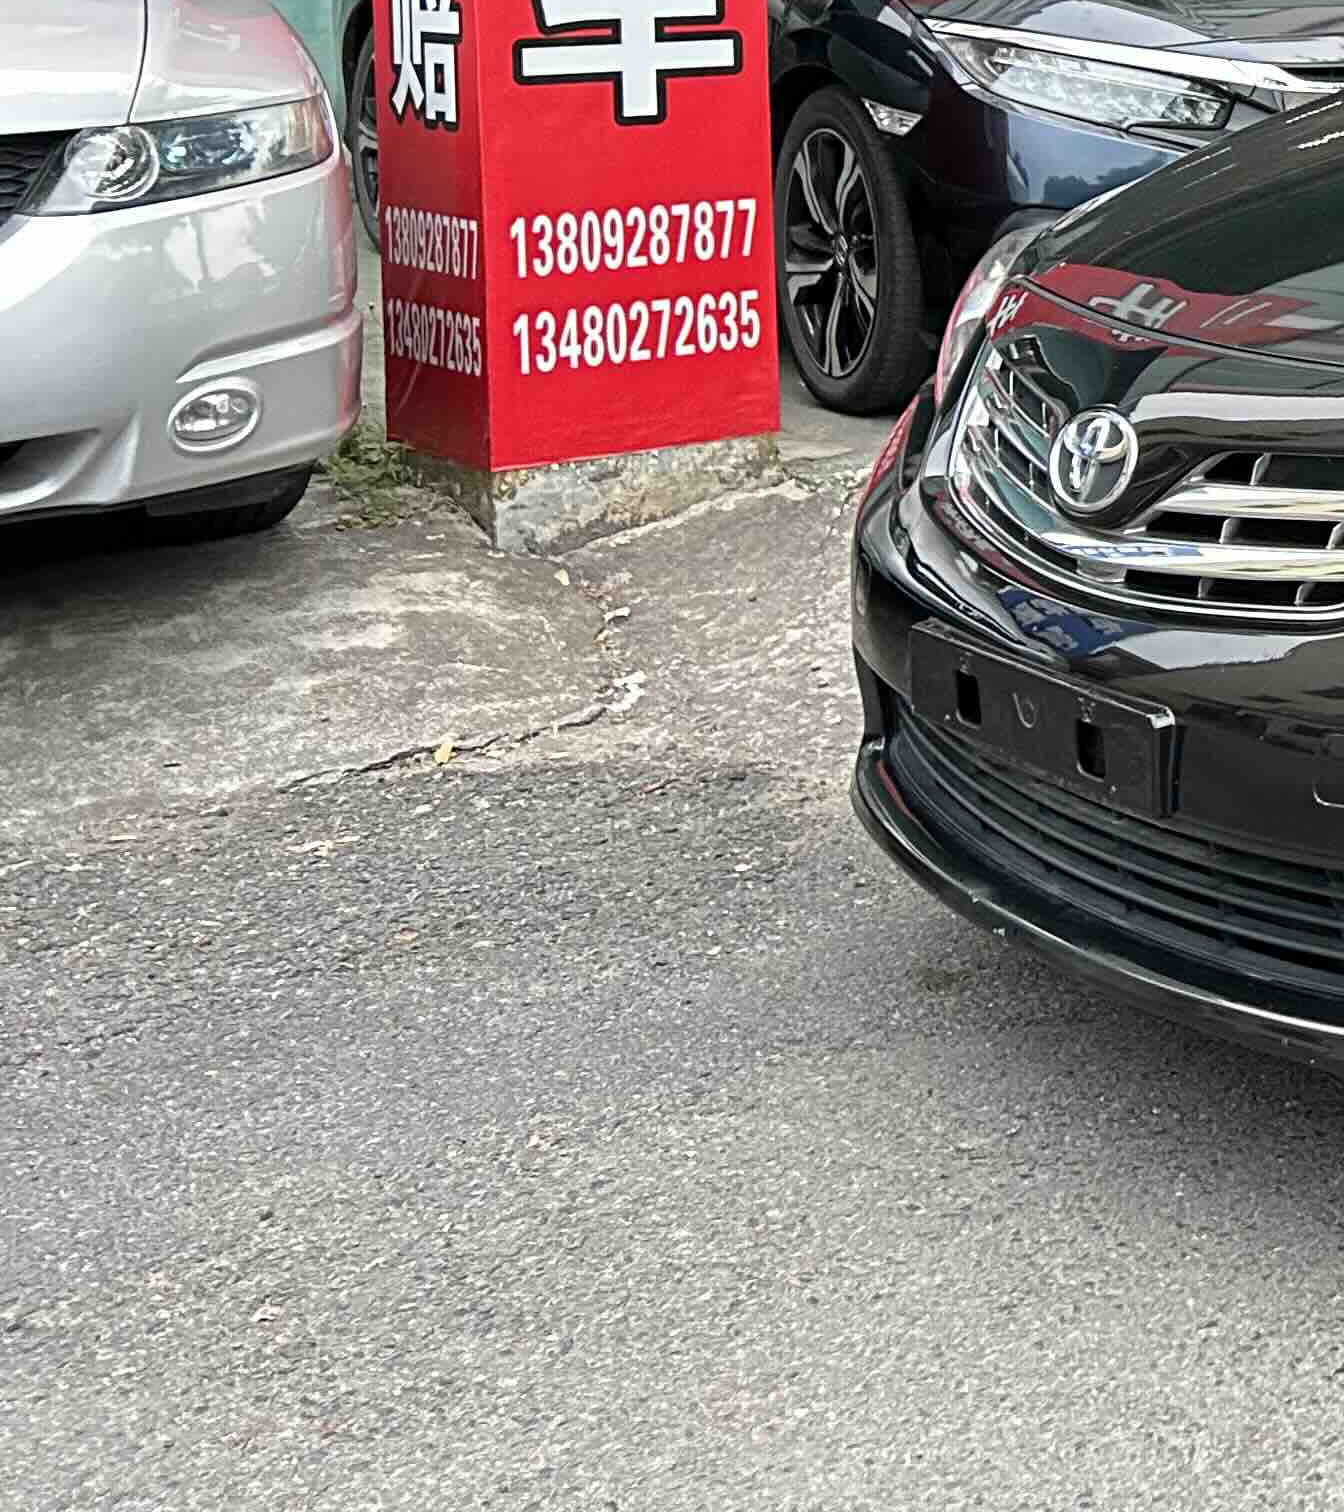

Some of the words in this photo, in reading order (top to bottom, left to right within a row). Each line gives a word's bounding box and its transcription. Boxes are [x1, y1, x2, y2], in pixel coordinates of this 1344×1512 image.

[385, 205, 478, 280] 13809287877
[509, 198, 757, 278] 13809287877
[386, 297, 482, 376] 13480272635
[512, 289, 761, 375] 13480272635
